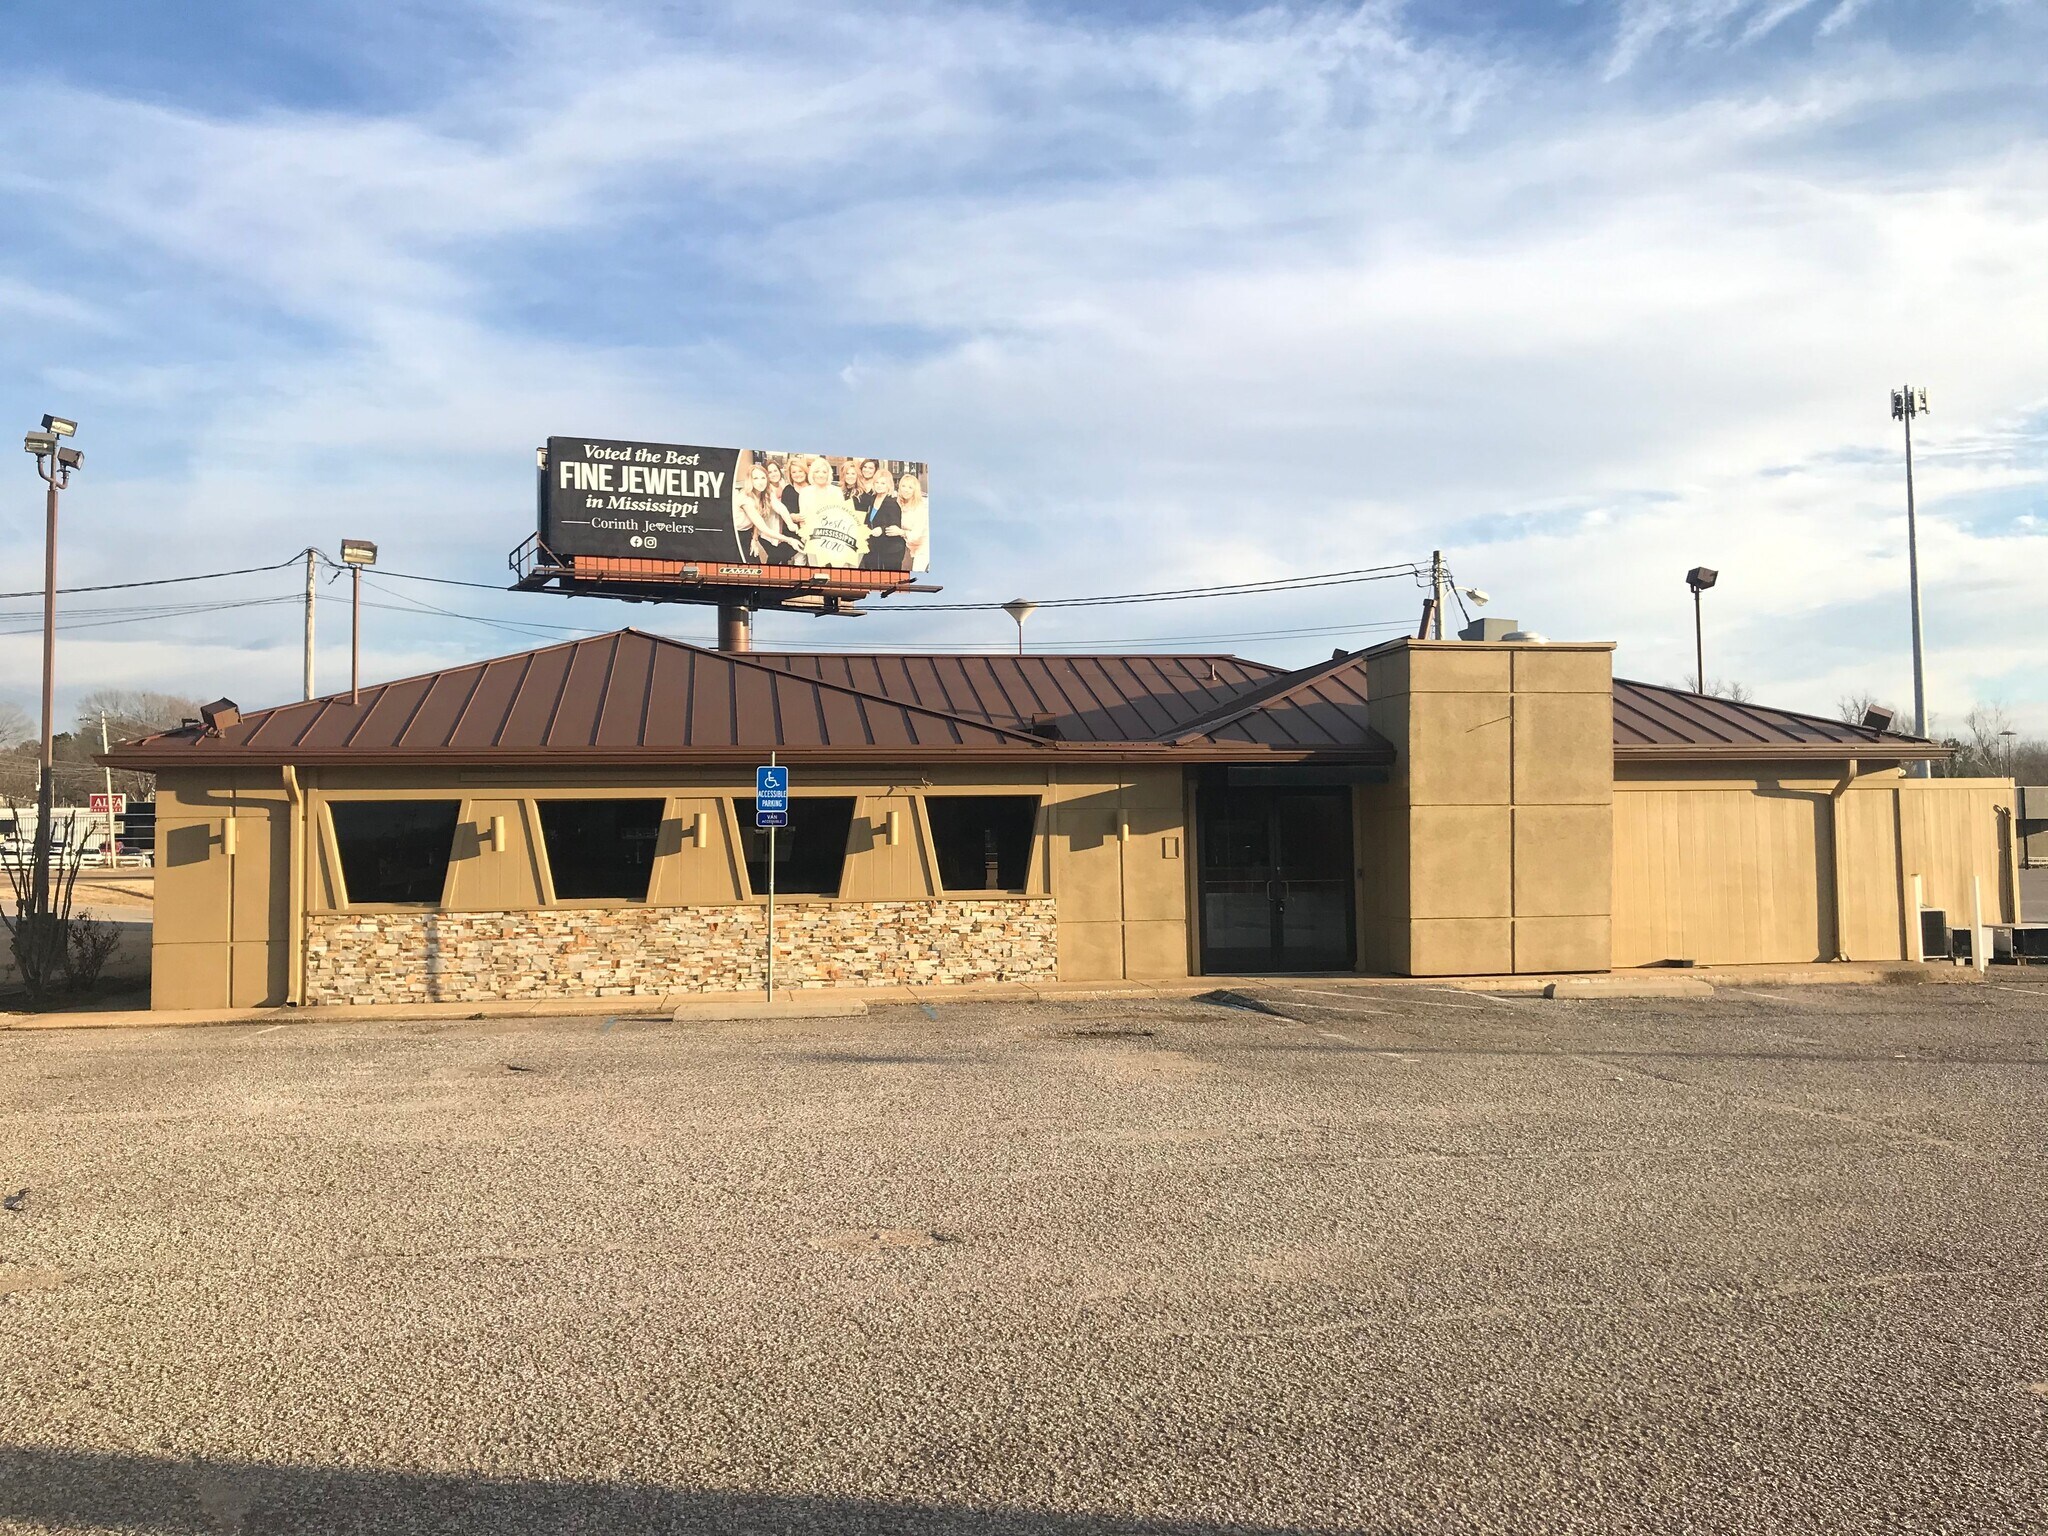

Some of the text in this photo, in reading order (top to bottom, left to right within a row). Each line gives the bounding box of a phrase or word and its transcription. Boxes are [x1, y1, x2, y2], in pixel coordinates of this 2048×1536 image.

[583, 444, 700, 466] Voted the Best
[560, 461, 725, 499] FINE JEWELRY
[586, 494, 699, 518] in Mississippi
[591, 517, 639, 531] Corinth
[820, 516, 844, 529] Best
[815, 529, 855, 545] MISSISSIPPI
[820, 538, 845, 552] 2020
[722, 567, 759, 575] LAMAR
[759, 790, 787, 798] ACCESSIBLE
